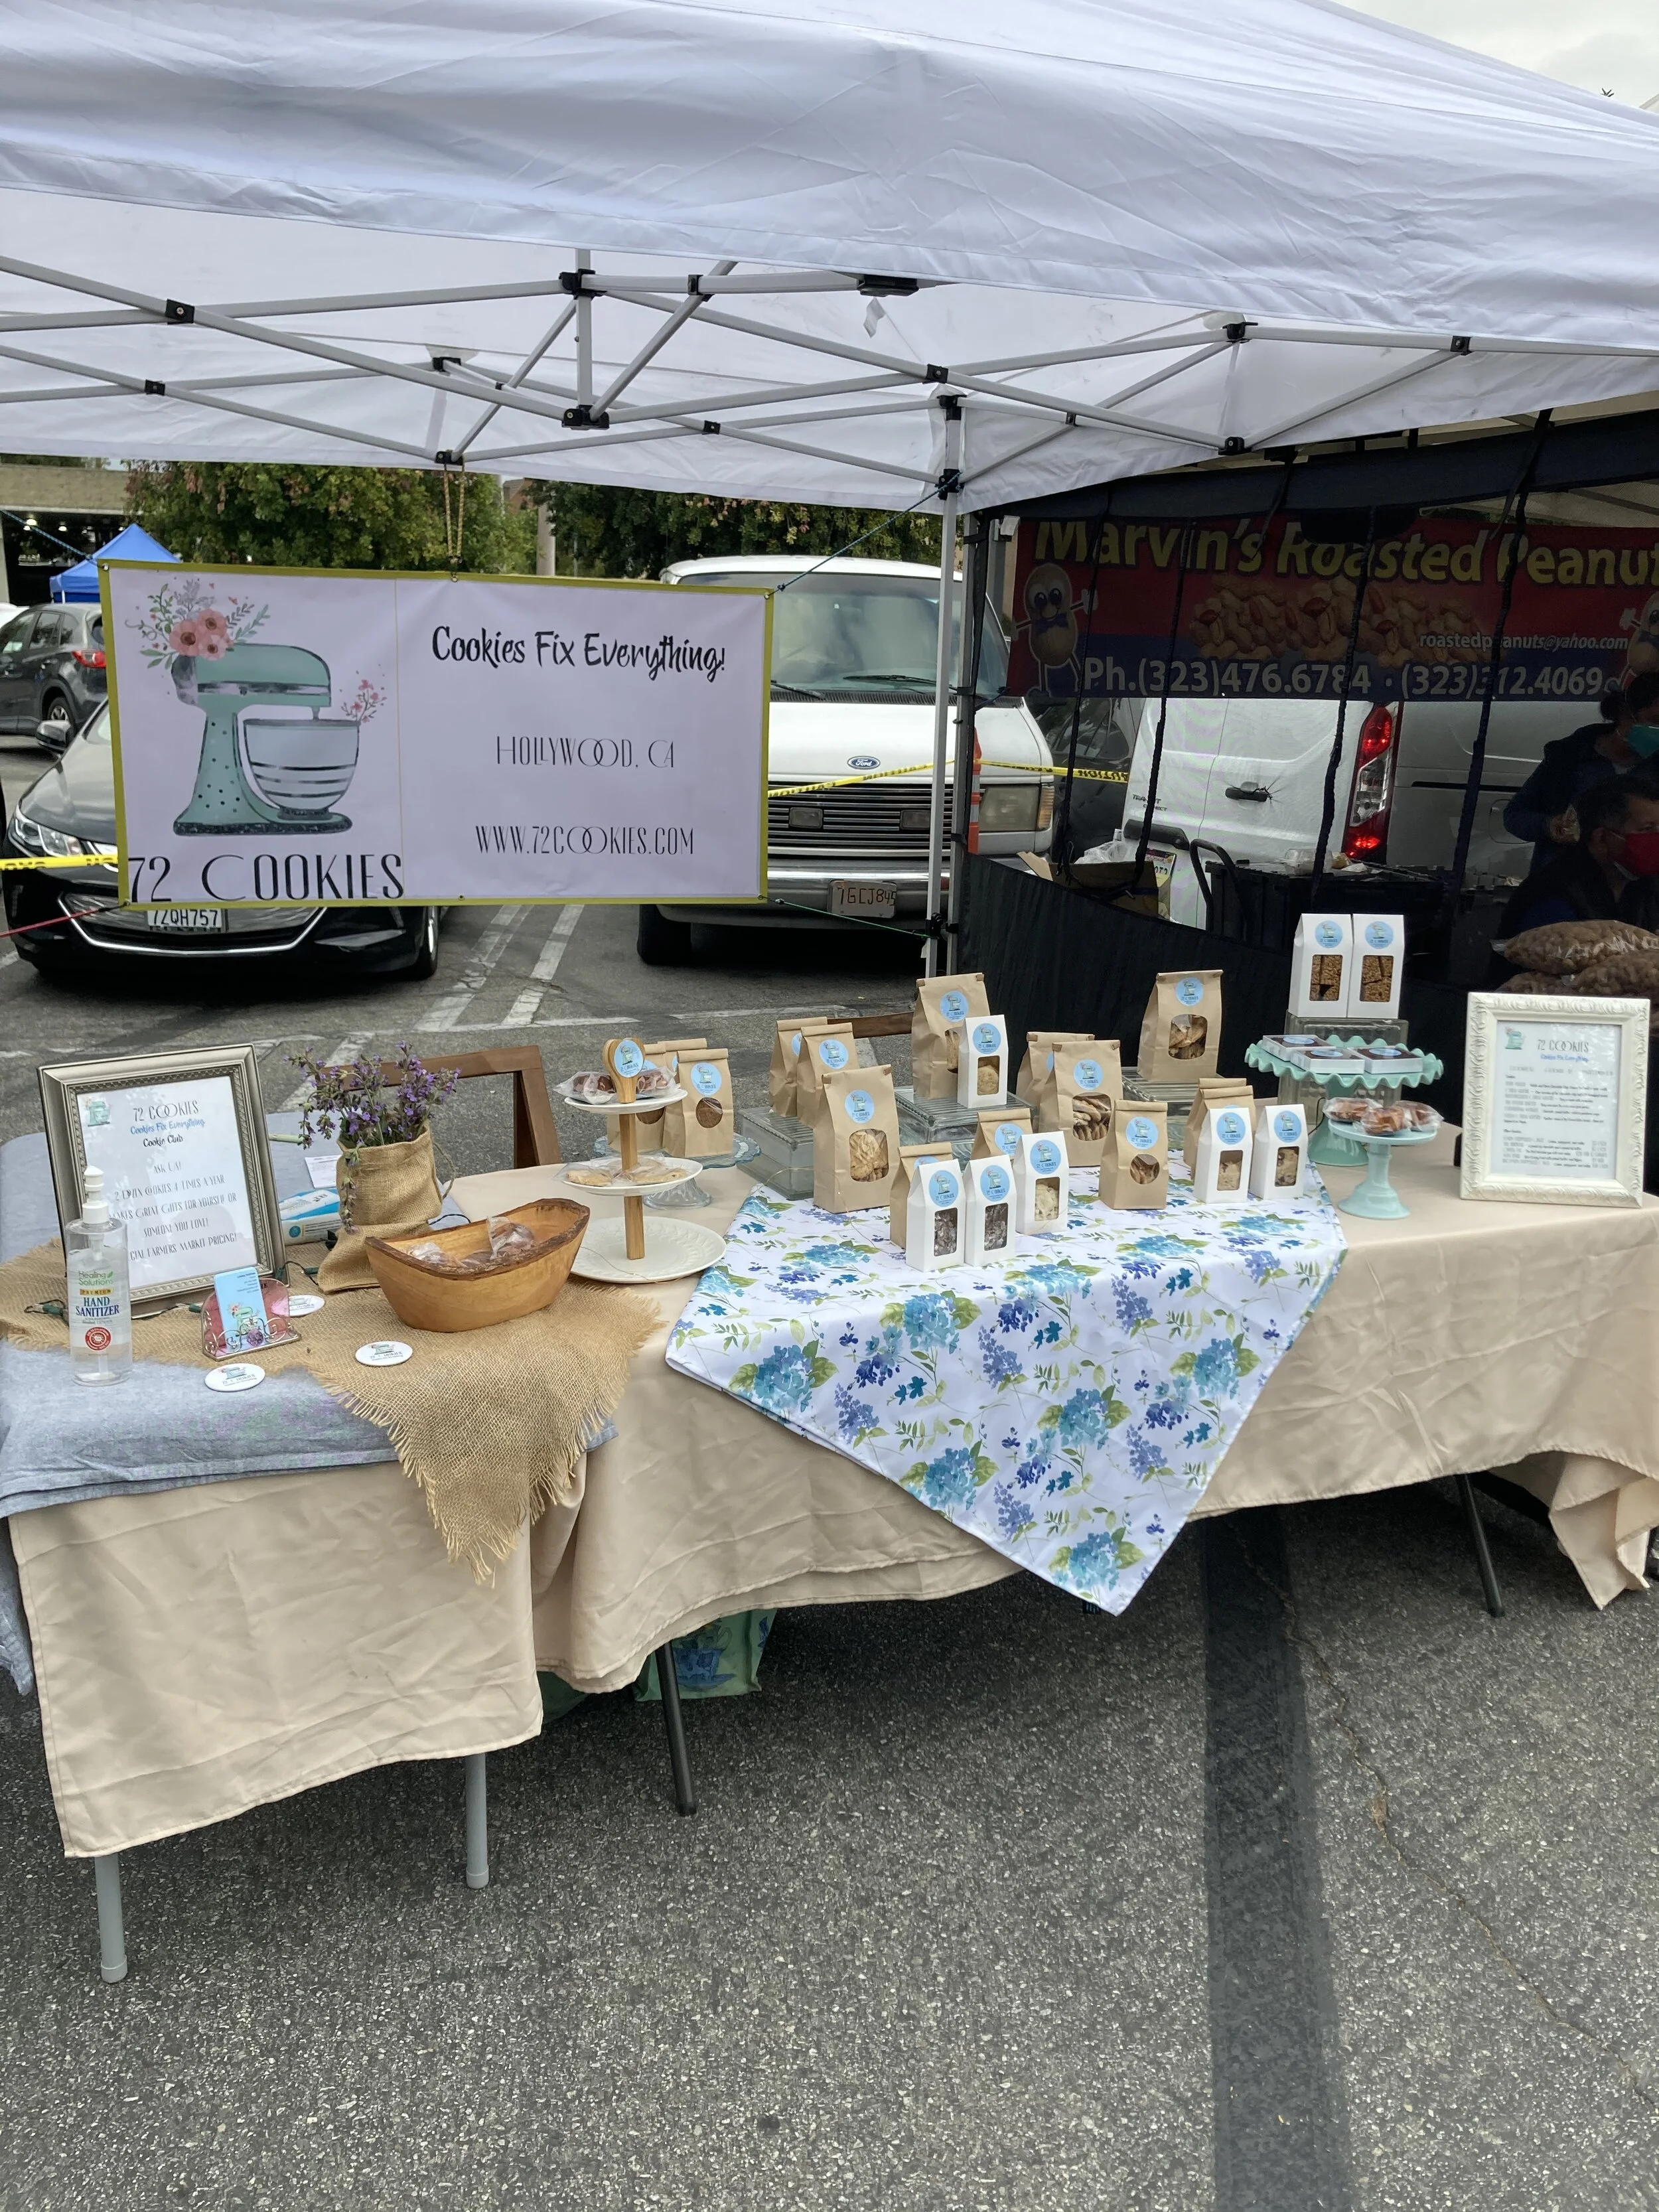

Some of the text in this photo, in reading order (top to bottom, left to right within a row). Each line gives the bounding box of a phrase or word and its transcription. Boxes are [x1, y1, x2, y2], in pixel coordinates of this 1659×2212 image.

[1277, 521, 1489, 581] Roasted
[1419, 631, 1628, 653] roastedpanuts@yahoo.com
[432, 625, 725, 682] Cookies Fix Everything!
[648, 739, 674, 769] CA
[1078, 770, 1128, 781] AUTION
[475, 825, 693, 855] WWW.72COOKIES.COM
[128, 853, 404, 903] 72 COOKIES
[837, 887, 897, 907] 7GCJ845
[1538, 1039, 1546, 1051] 72
[133, 1100, 199, 1122] 72 COOKIES
[131, 1124, 154, 1135] Cookies
[157, 1122, 167, 1132] Fix
[143, 1134, 183, 1147] Cookie Club
[115, 1192, 120, 1201] 2
[182, 1179, 201, 1191] TIMES
[209, 1175, 225, 1185] YEAR
[228, 1192, 237, 1203] OR
[175, 1220, 188, 1232] YOU
[78, 1278, 114, 1286] Solutions
[84, 1297, 110, 1307] HAND
[76, 1305, 119, 1317] SANITIZER
